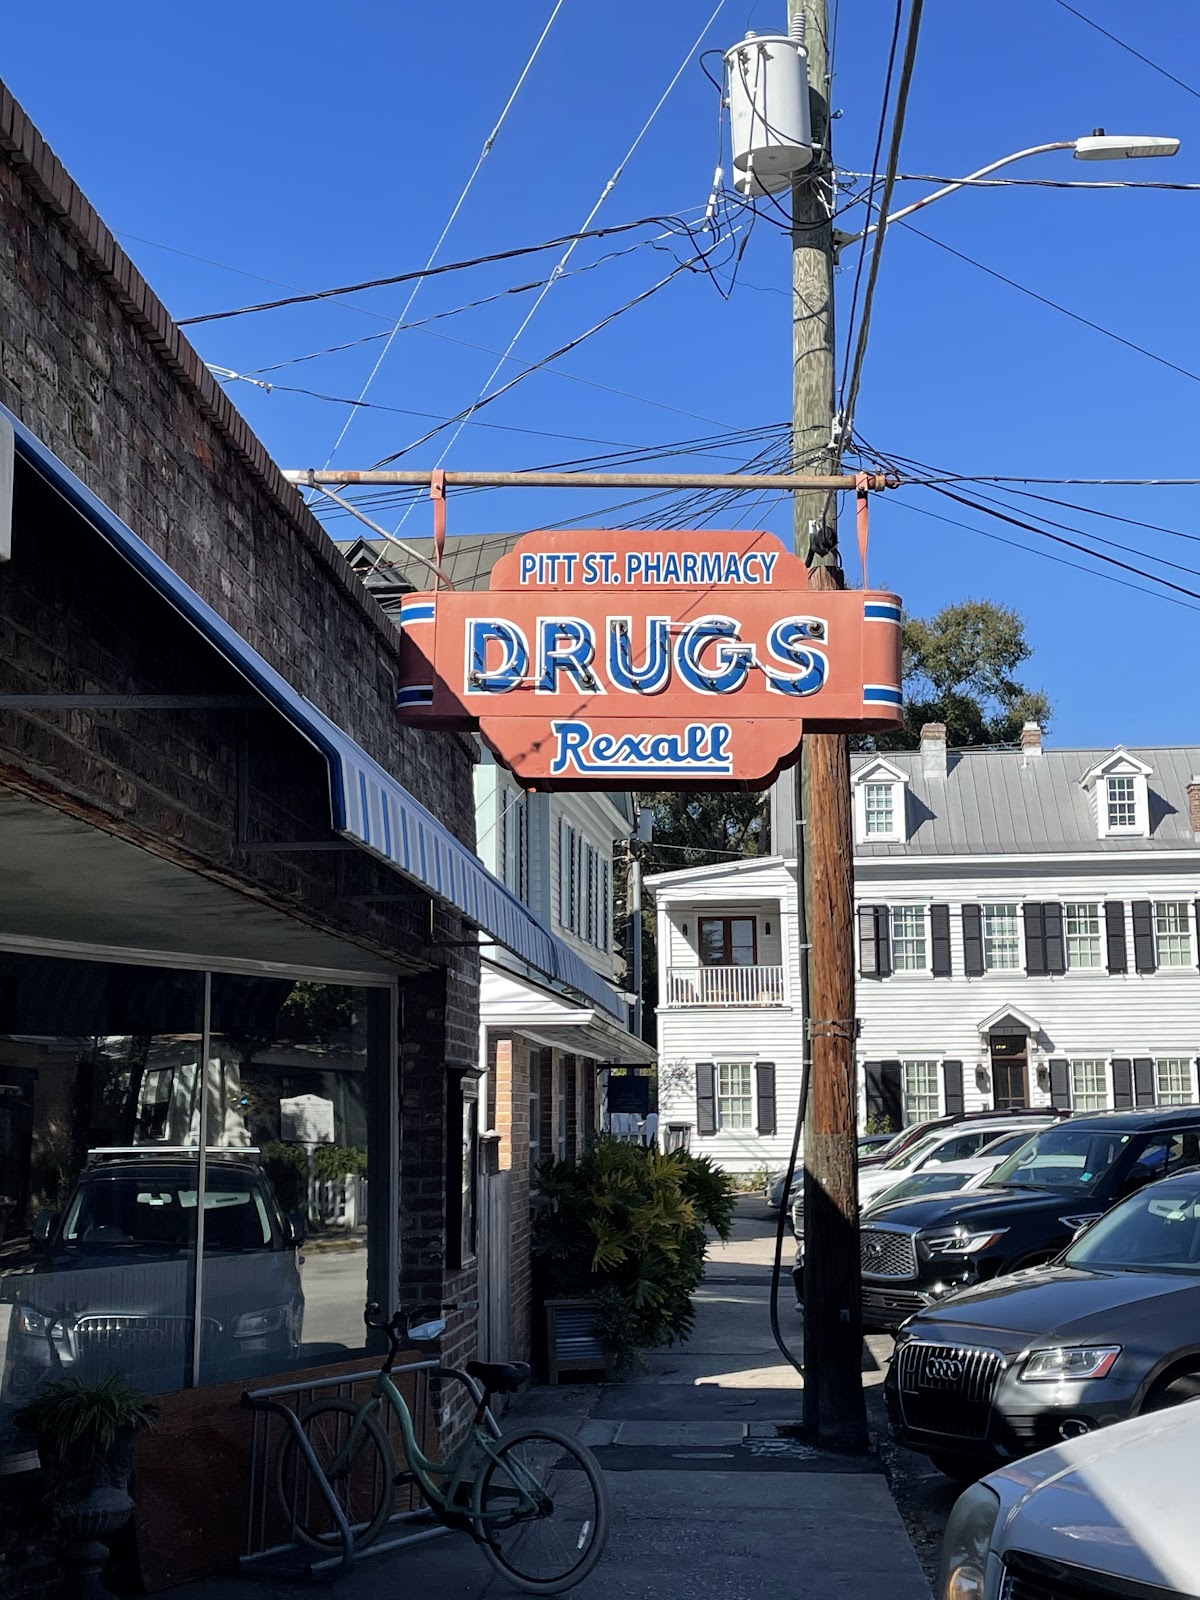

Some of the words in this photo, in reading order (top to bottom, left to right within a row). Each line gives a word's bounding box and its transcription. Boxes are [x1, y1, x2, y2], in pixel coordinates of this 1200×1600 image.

[520, 552, 579, 585] PITT
[582, 552, 621, 585] ST.
[625, 552, 779, 584] PHARMACY
[464, 614, 829, 697] DRUGS
[550, 720, 733, 775] Rexall
